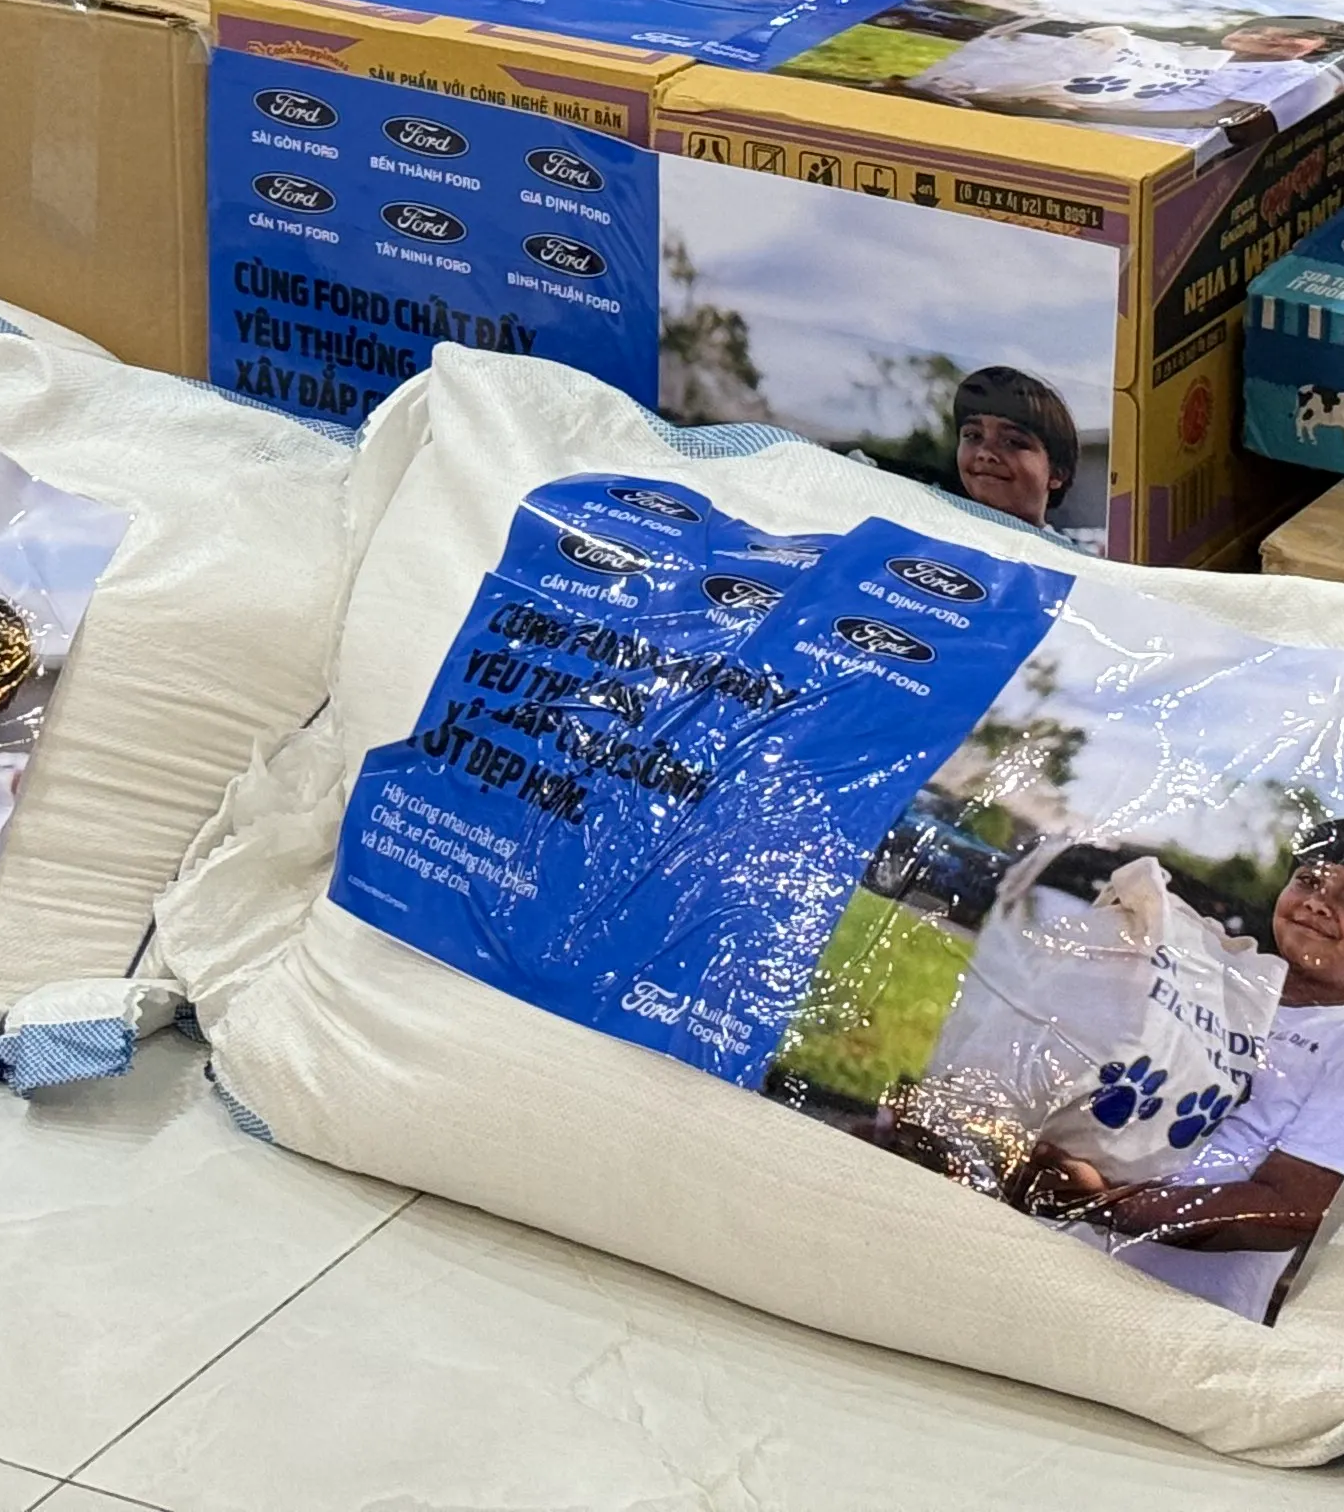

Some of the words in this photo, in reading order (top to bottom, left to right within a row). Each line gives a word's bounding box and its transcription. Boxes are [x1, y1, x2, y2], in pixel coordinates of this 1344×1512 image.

[269, 91, 322, 125] Ford
[469, 83, 506, 107] CÔNG
[304, 140, 340, 160] FORD
[398, 119, 453, 153] Ford
[444, 171, 482, 192] FORD
[542, 151, 592, 187] Ford
[268, 175, 321, 209] Ford
[917, 183, 934, 194] UP
[396, 204, 449, 239] Ford
[519, 189, 544, 207] GIA
[580, 205, 612, 227] FORD
[1045, 203, 1062, 220] kg
[304, 224, 340, 245] FORD
[400, 246, 434, 266] NINH
[435, 254, 473, 276] FORD
[539, 236, 591, 273] Ford
[233, 255, 310, 308] CÙNG
[313, 278, 391, 327] FORD
[584, 293, 622, 315] FORD
[232, 308, 293, 353] YÊU
[233, 355, 295, 400] XÂY
[620, 488, 687, 523] Ford
[640, 514, 683, 539] FORD
[901, 560, 965, 599] Ford
[858, 578, 887, 599] GIA
[925, 603, 971, 631] FORD
[851, 619, 913, 658] Ford
[885, 668, 931, 698] FORD
[466, 738, 526, 794] ĐẸP
[420, 826, 455, 854] Ford
[439, 810, 470, 836] nhau
[620, 980, 692, 1027] Ford
[690, 999, 754, 1041] Building
[686, 1017, 751, 1057] Together
